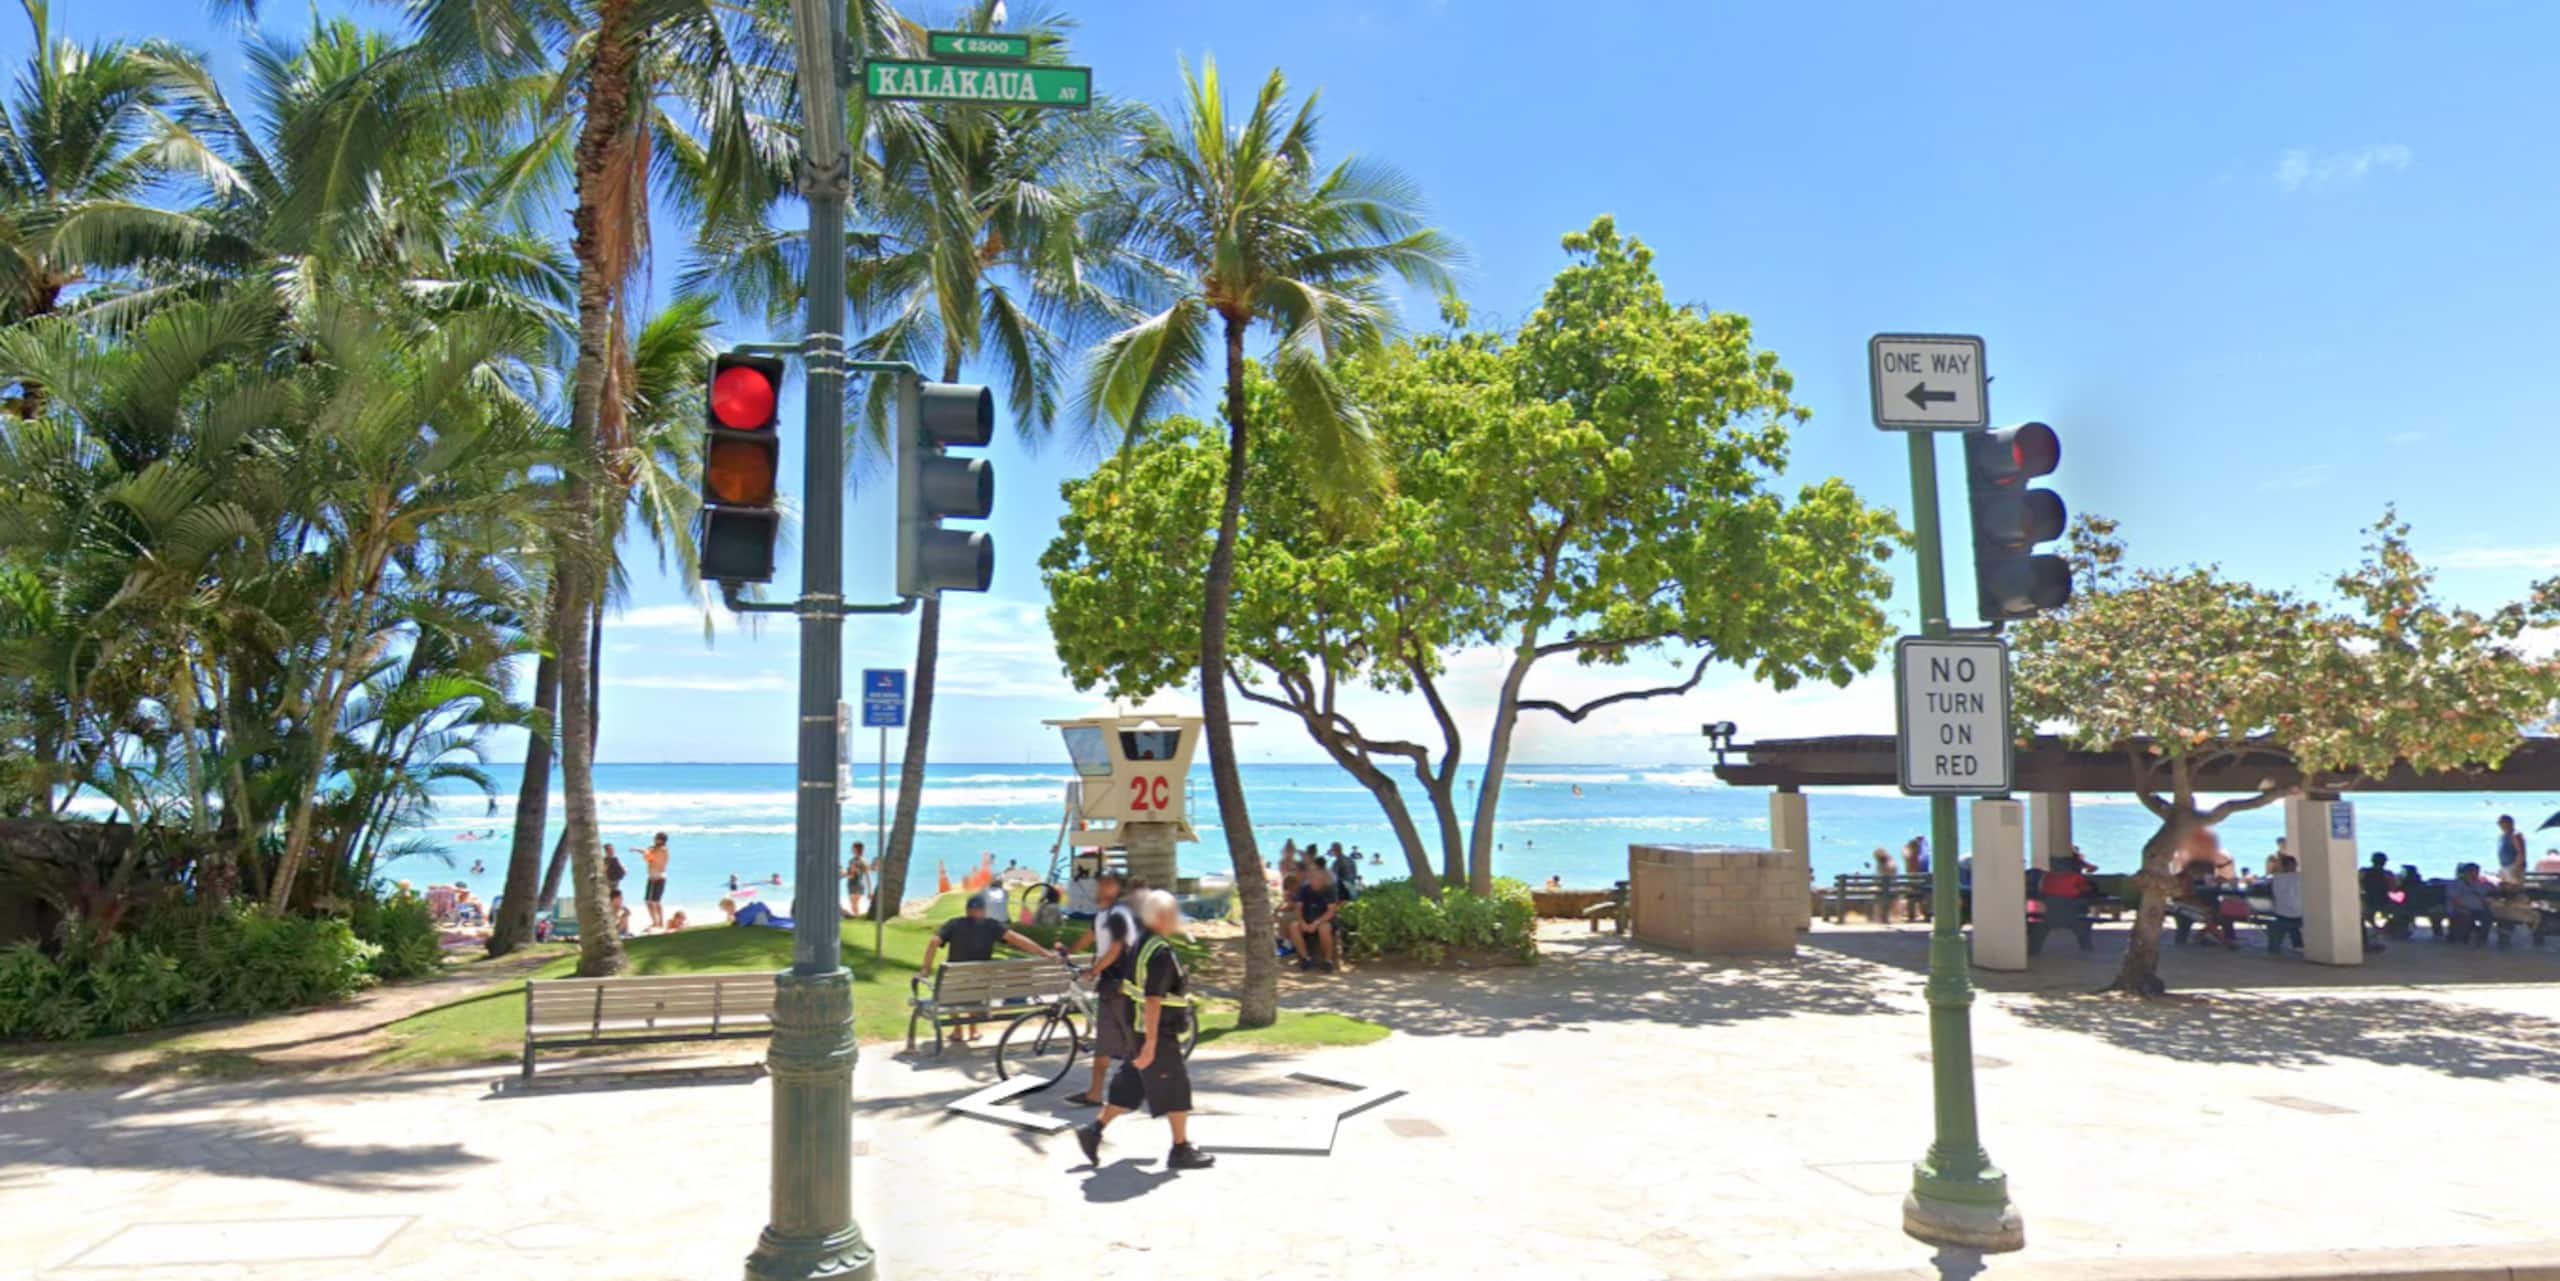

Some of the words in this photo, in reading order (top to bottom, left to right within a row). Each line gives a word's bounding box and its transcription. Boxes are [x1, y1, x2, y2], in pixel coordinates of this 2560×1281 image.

[1058, 87, 1078, 100] AV
[1883, 352, 1922, 373] ONE
[1931, 354, 1971, 374] WAY
[1930, 656, 1976, 683] NO
[1925, 691, 1984, 714] TURN
[1939, 723, 1972, 745] ON
[1935, 754, 1978, 776] RED
[1130, 775, 1169, 811] 2C
